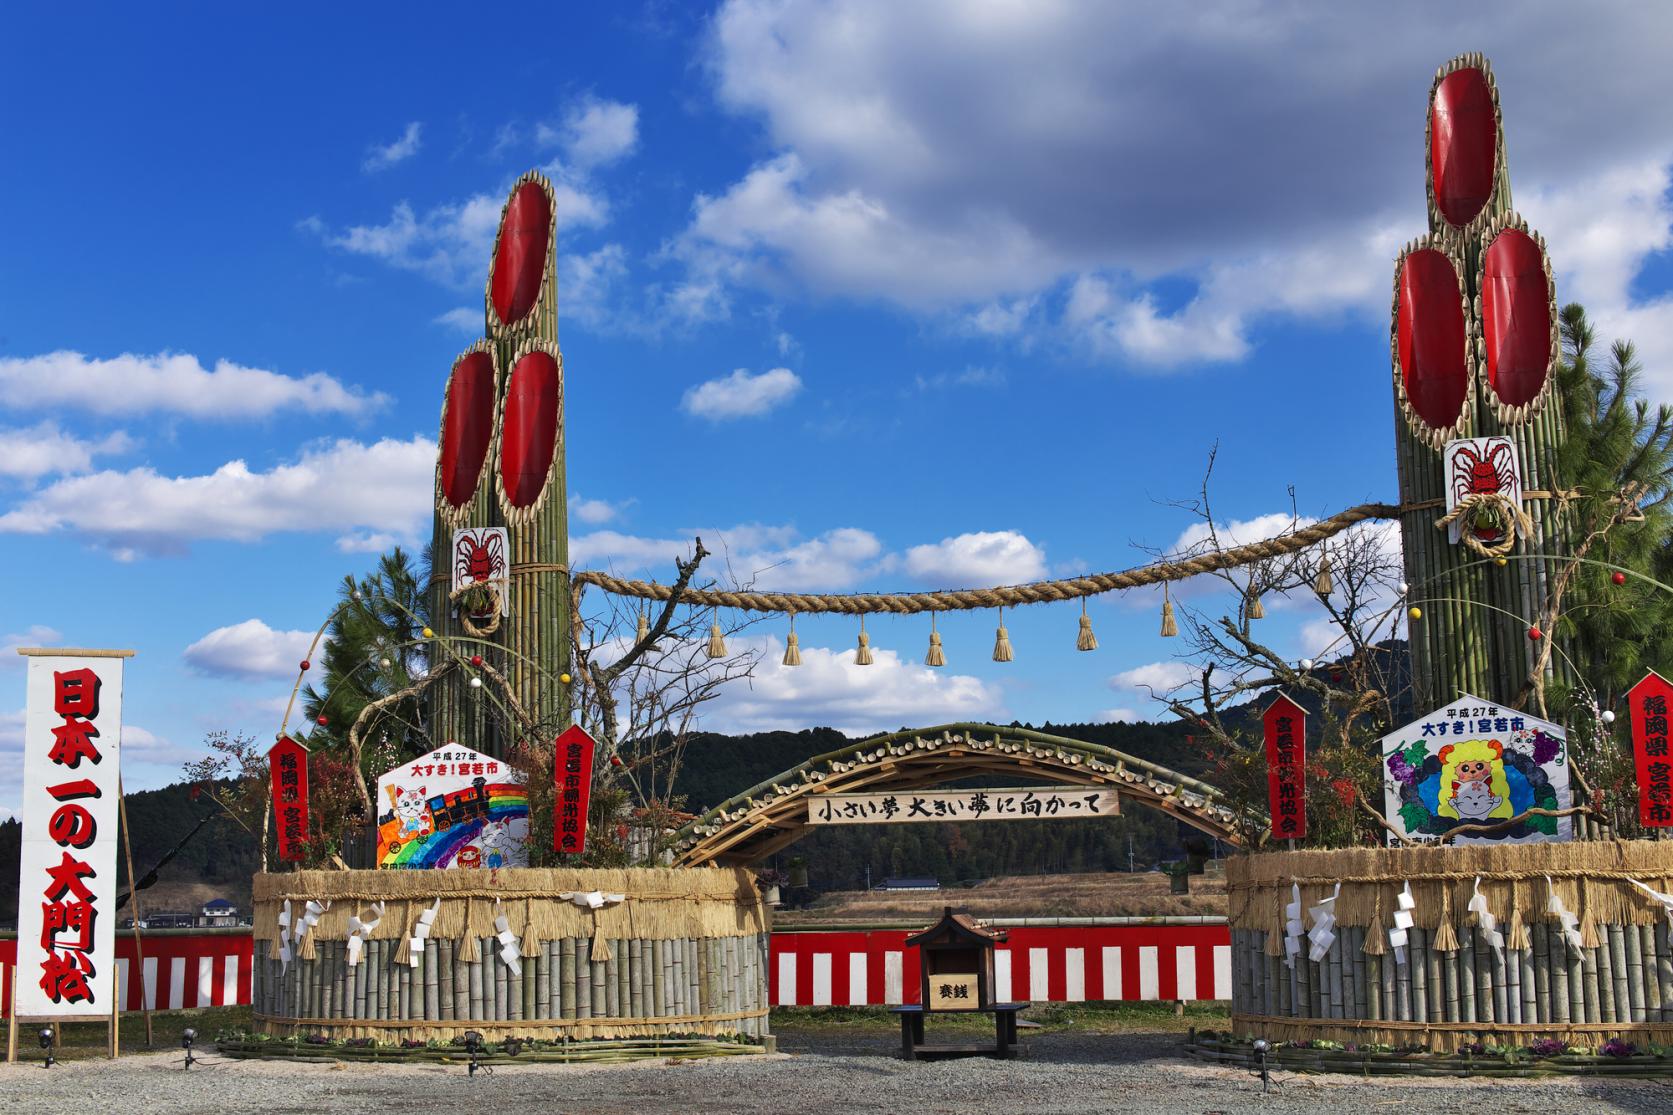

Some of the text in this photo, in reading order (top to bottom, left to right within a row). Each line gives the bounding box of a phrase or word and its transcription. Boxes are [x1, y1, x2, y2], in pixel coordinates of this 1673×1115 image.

[1447, 706, 1499, 720] 平成27年
[1422, 716, 1525, 737] 大すき！宮若市
[432, 752, 478, 762] 平成27年
[411, 762, 499, 777] 大すき！宮若市
[939, 983, 969, 999] 賽銭
